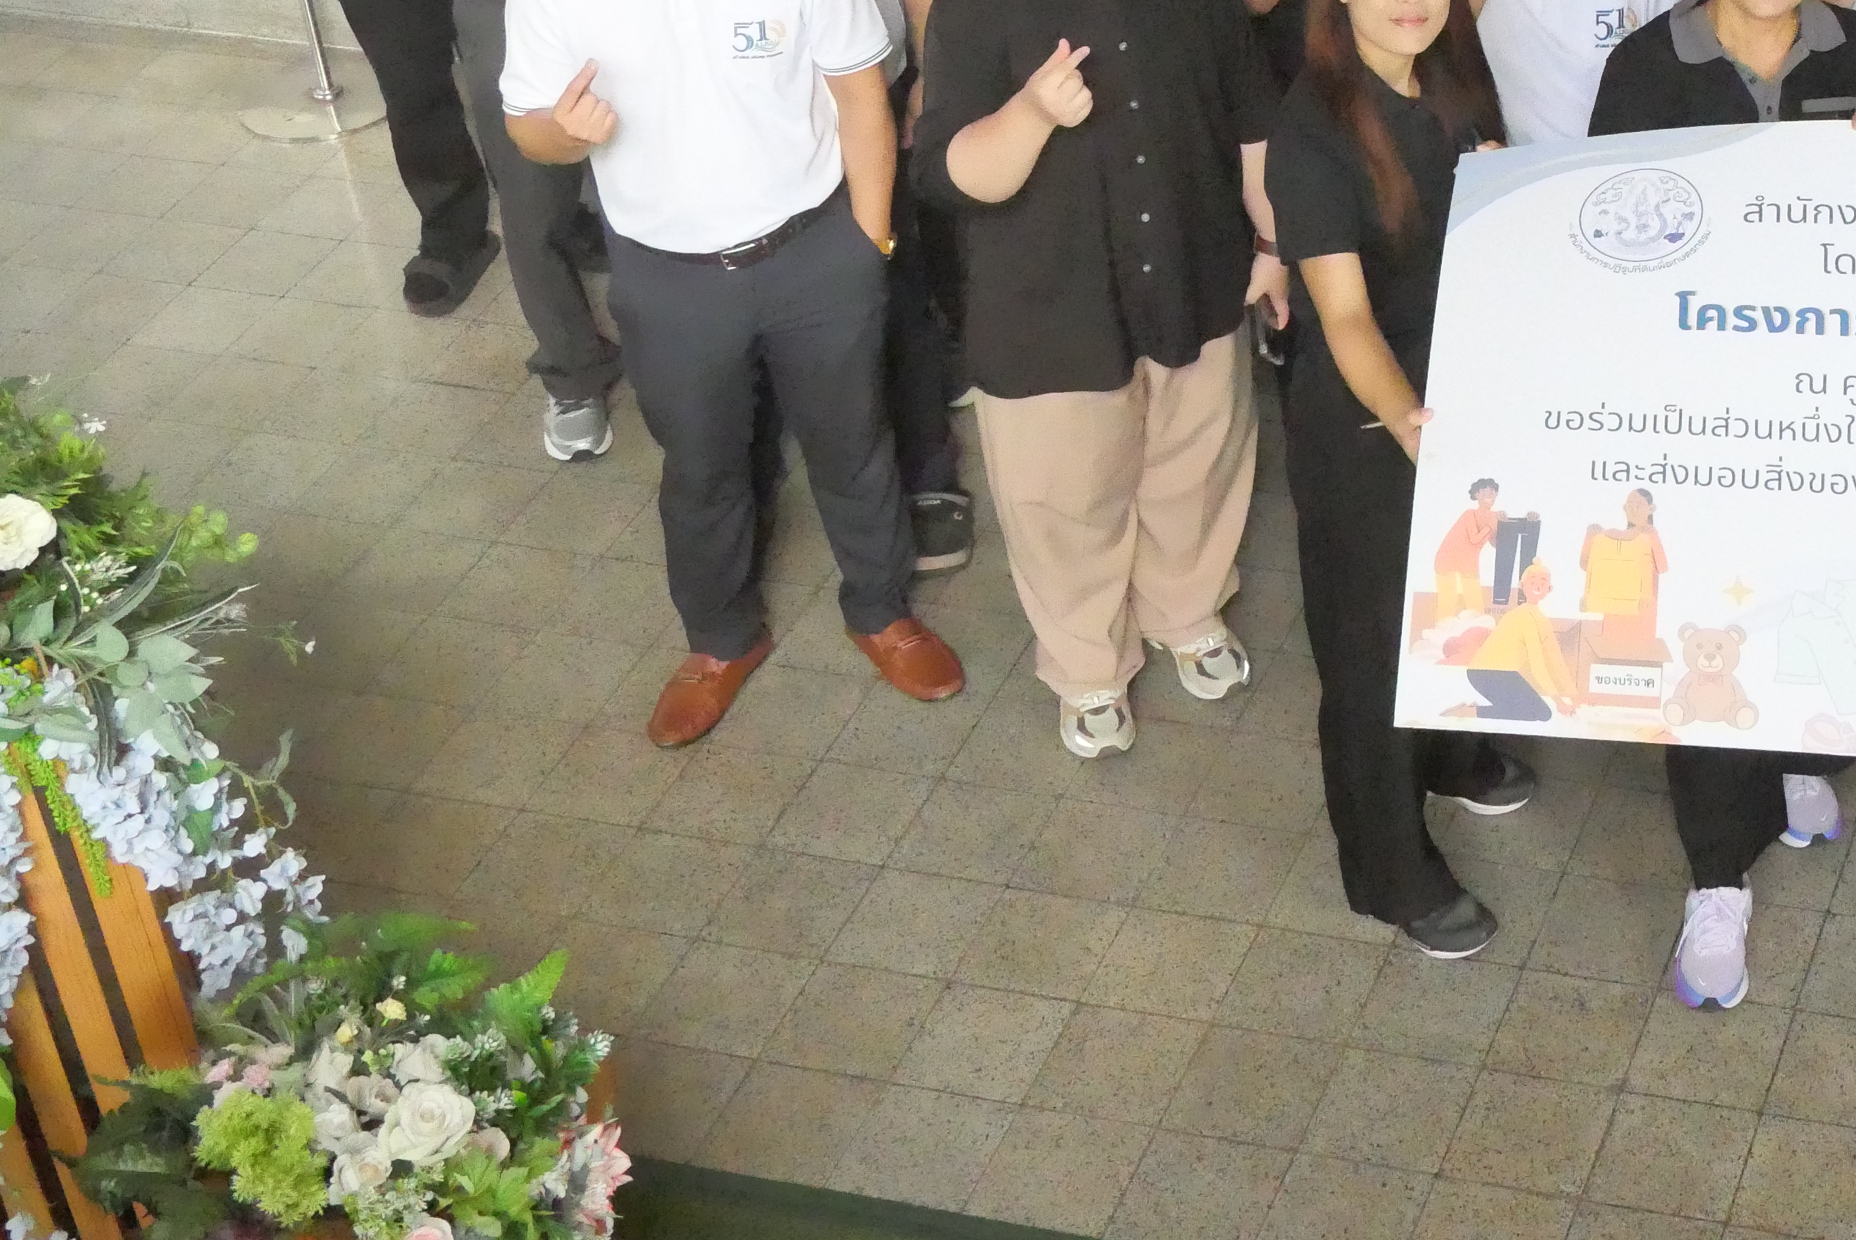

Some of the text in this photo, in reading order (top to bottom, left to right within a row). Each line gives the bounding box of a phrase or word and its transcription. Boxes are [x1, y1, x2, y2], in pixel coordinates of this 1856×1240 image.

[732, 19, 771, 53] 51
[1594, 8, 1626, 41] 51
[1794, 371, 1828, 396] ณ
[1594, 673, 1656, 689] ของบริจาค
